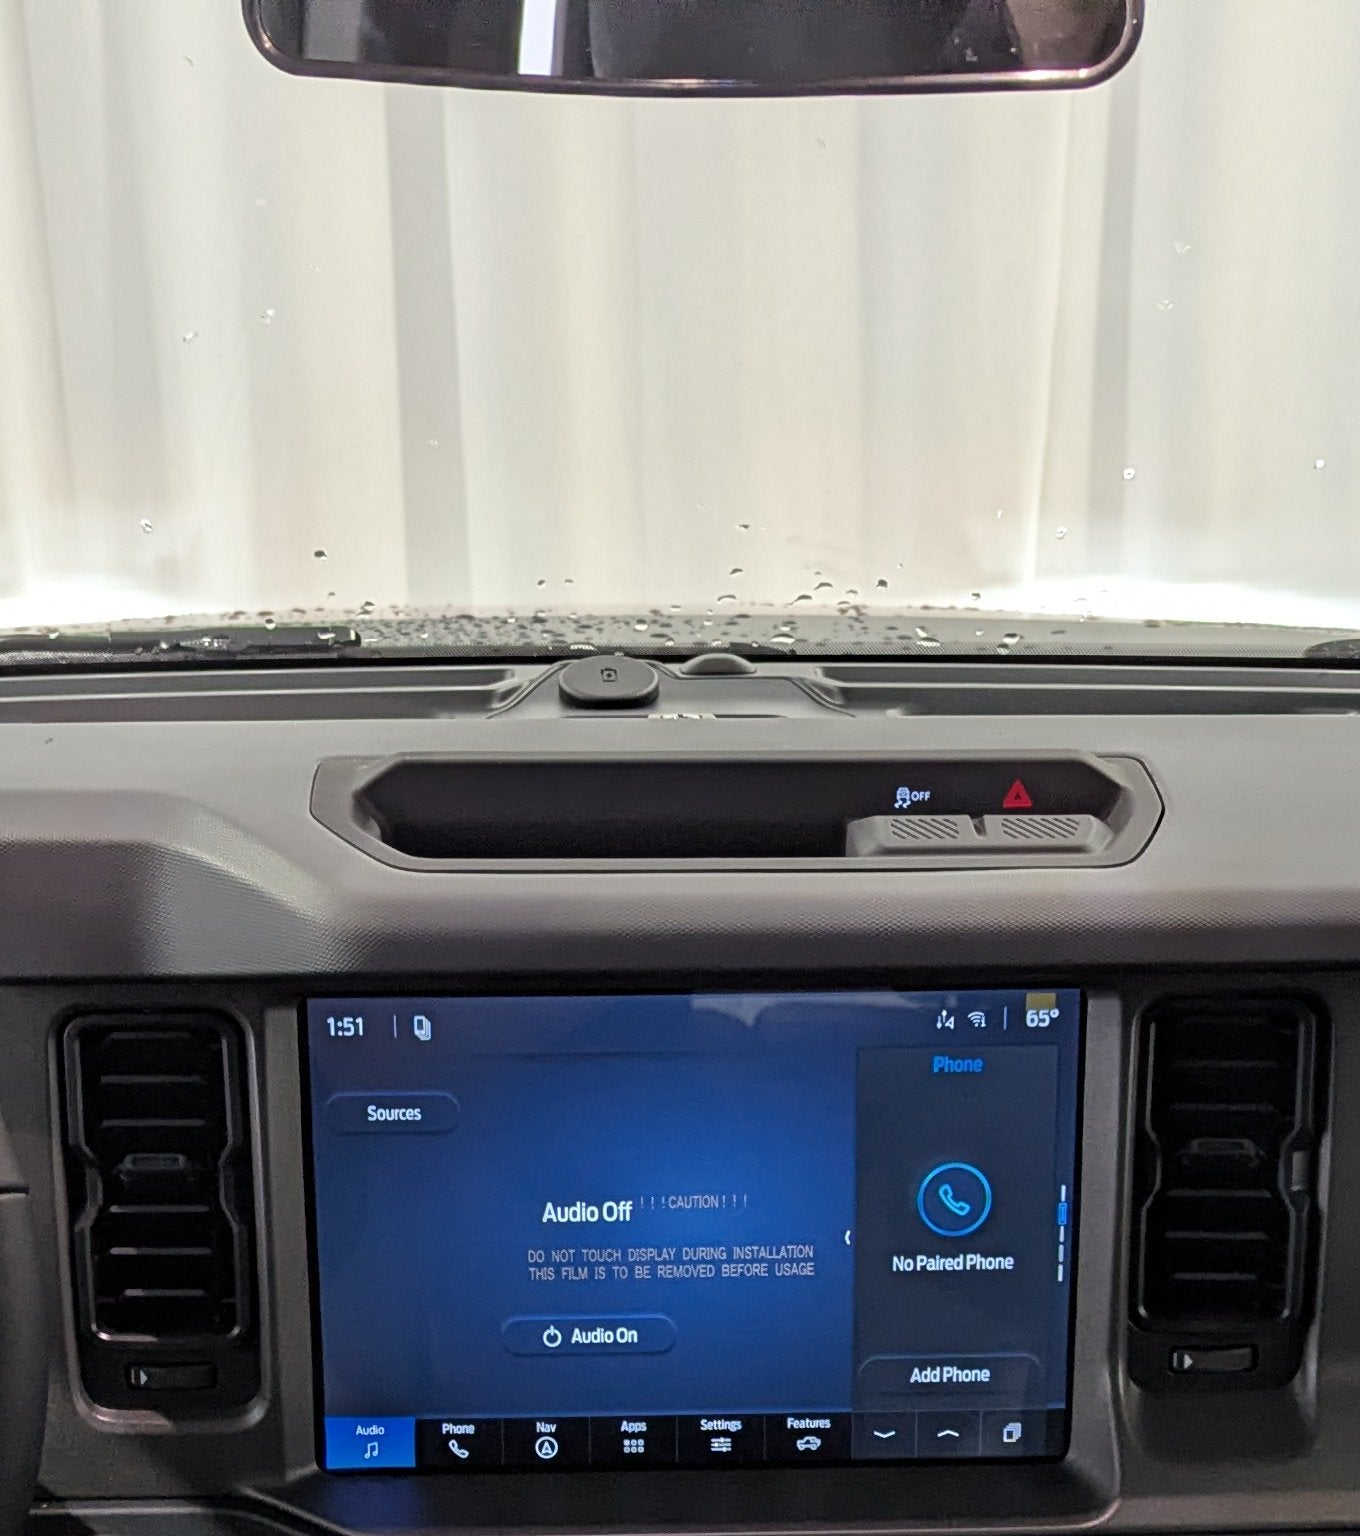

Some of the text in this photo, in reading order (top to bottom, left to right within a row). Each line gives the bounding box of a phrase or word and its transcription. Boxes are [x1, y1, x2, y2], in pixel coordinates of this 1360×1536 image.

[911, 791, 931, 801] OFF
[326, 1016, 364, 1037] 1:51
[933, 1055, 984, 1073] Phone
[367, 1105, 422, 1121] Sources
[542, 1200, 634, 1223] Audio Off
[527, 1244, 814, 1263] DO NOT TOUCH DISPLAY DURING INSTALLATION
[892, 1253, 1015, 1271] No Paired Phone
[529, 1262, 815, 1281] THIS FILM IS TO BE REMOVED BEFORE USAGE
[571, 1326, 638, 1344] Audio On
[909, 1366, 991, 1383] Add Phone
[355, 1424, 385, 1436] Audio
[441, 1423, 476, 1435] Phone
[535, 1421, 557, 1433] Nav
[620, 1420, 648, 1433] Apps
[700, 1418, 742, 1432] Settings
[787, 1417, 831, 1430] Features
